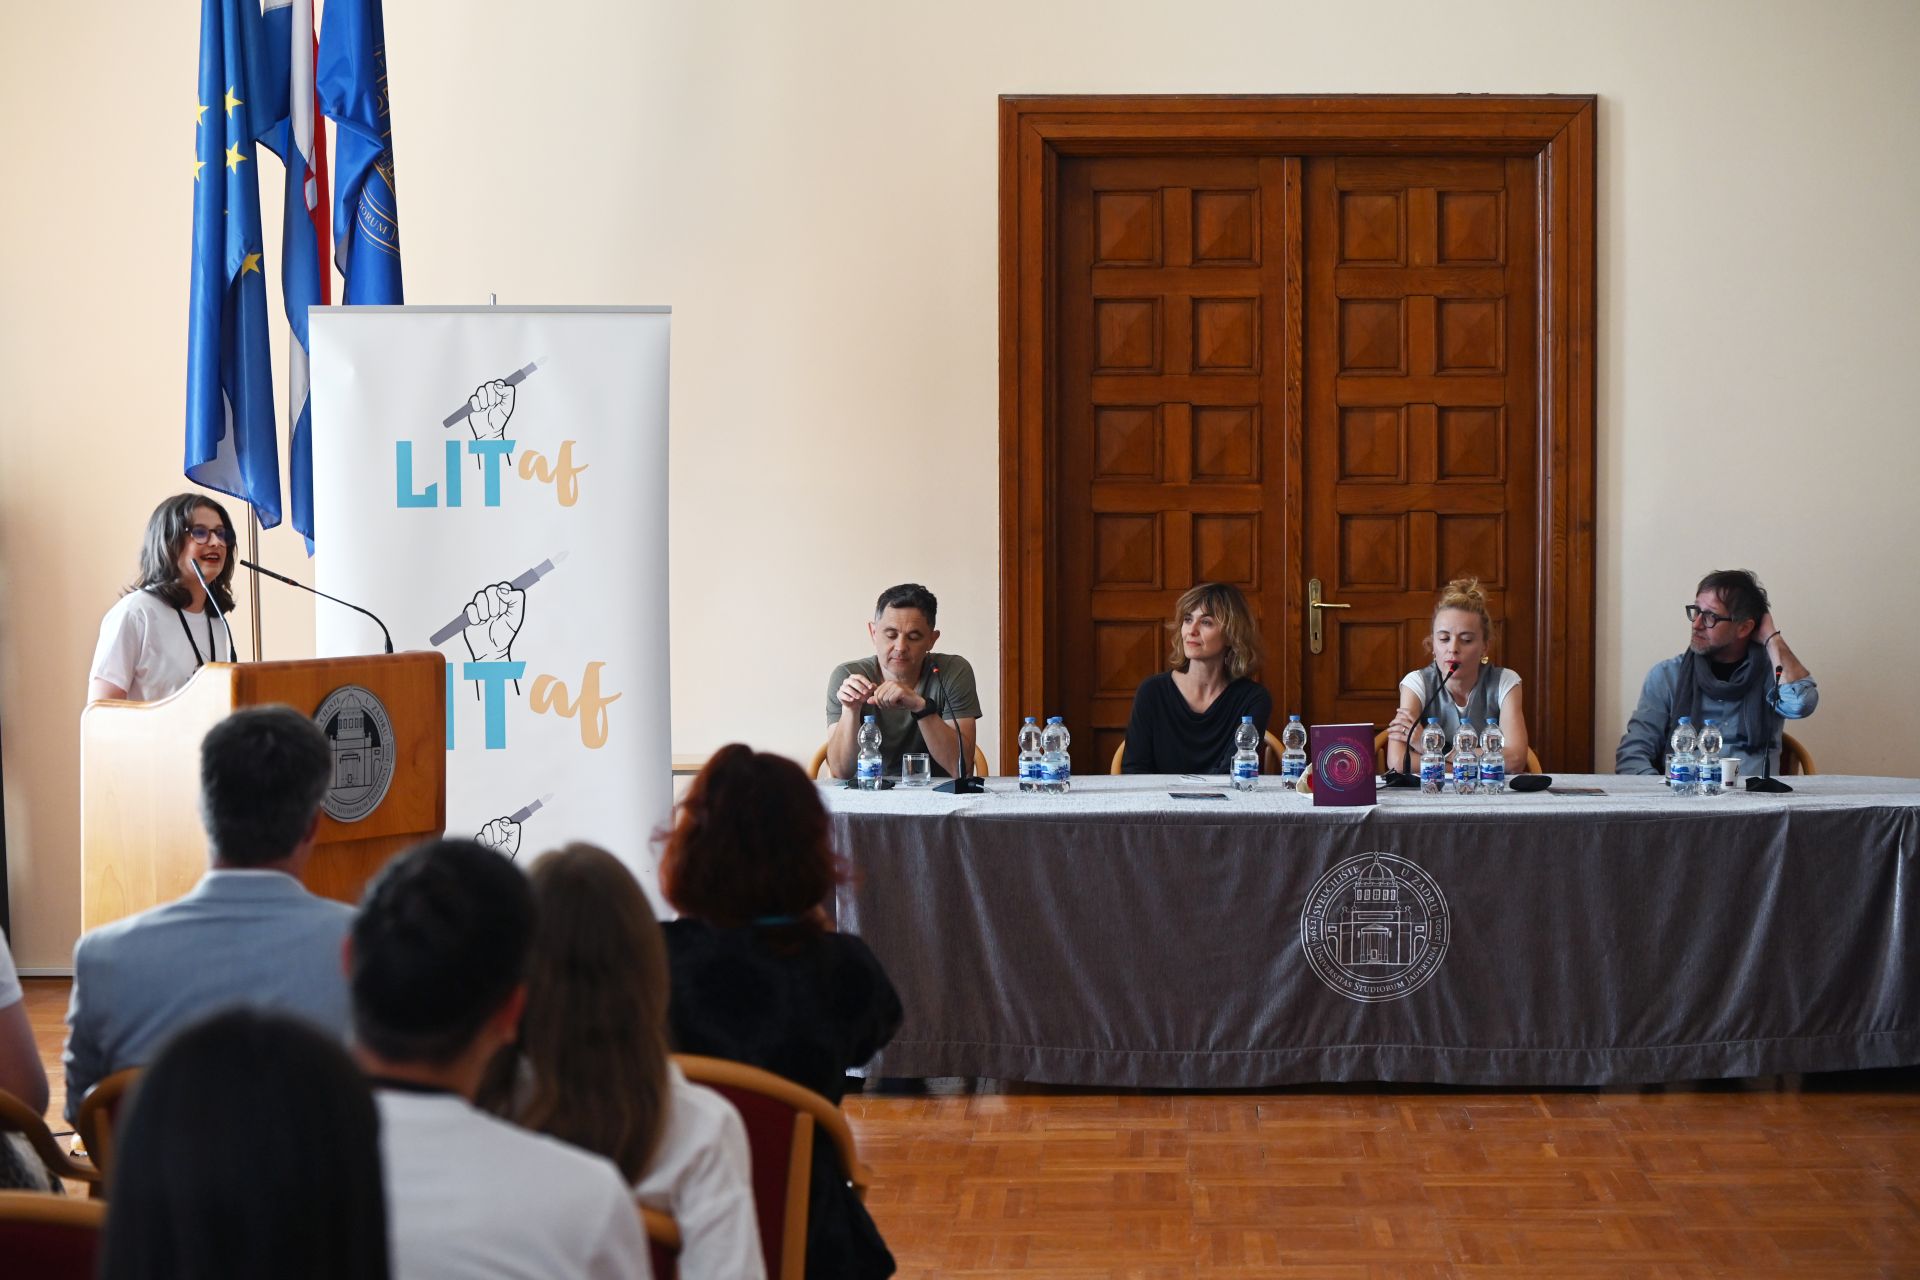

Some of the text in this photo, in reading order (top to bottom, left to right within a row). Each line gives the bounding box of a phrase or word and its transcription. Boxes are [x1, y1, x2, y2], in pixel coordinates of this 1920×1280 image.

[1400, 867, 1410, 877] U
[1411, 875, 1440, 912] ZADRU
[1353, 981, 1406, 993] STUDIORUM
[1404, 946, 1439, 987] JADERTINA
